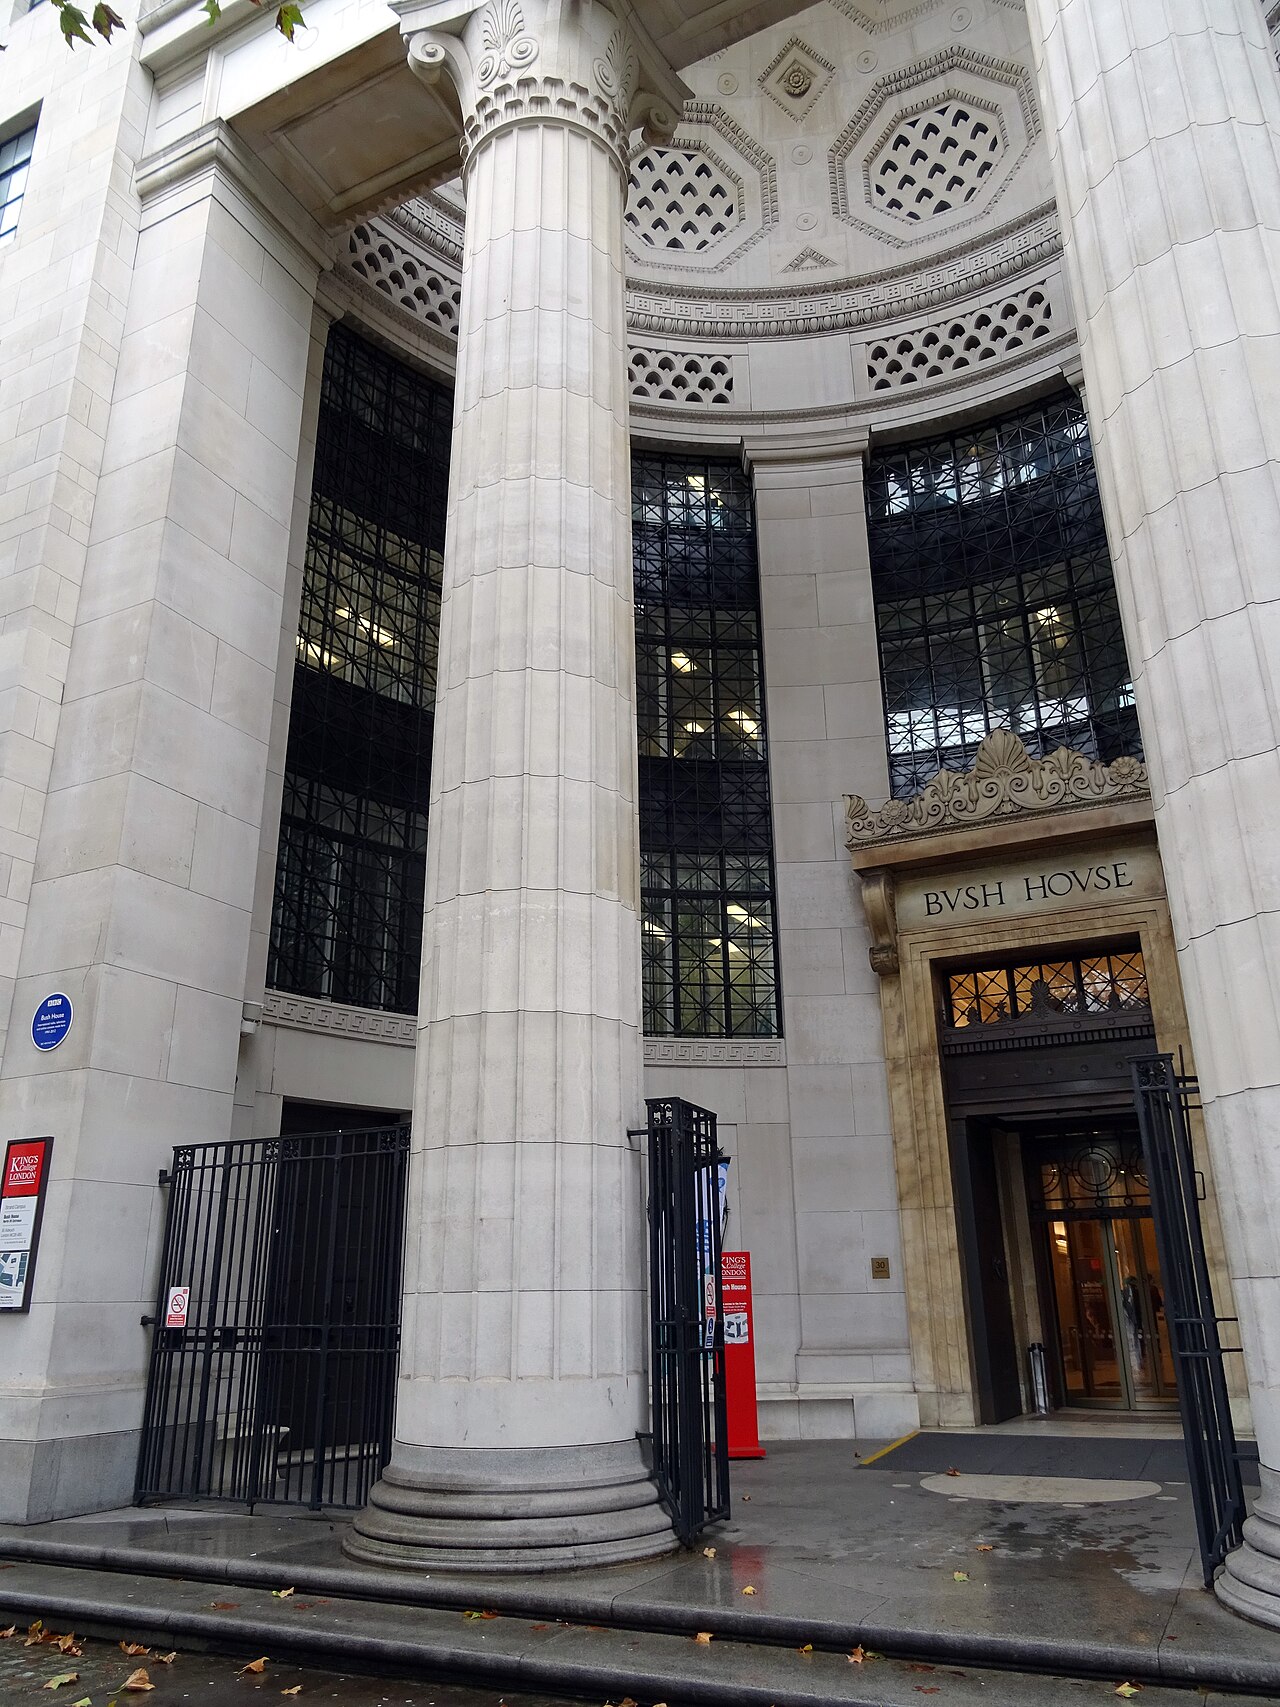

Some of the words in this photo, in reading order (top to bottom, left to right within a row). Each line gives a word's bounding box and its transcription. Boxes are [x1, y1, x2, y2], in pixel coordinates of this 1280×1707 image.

[923, 881, 1006, 917] BVSH
[1023, 861, 1133, 902] HOVSE
[19, 1163, 37, 1171] College
[10, 1172, 36, 1180] LONDON
